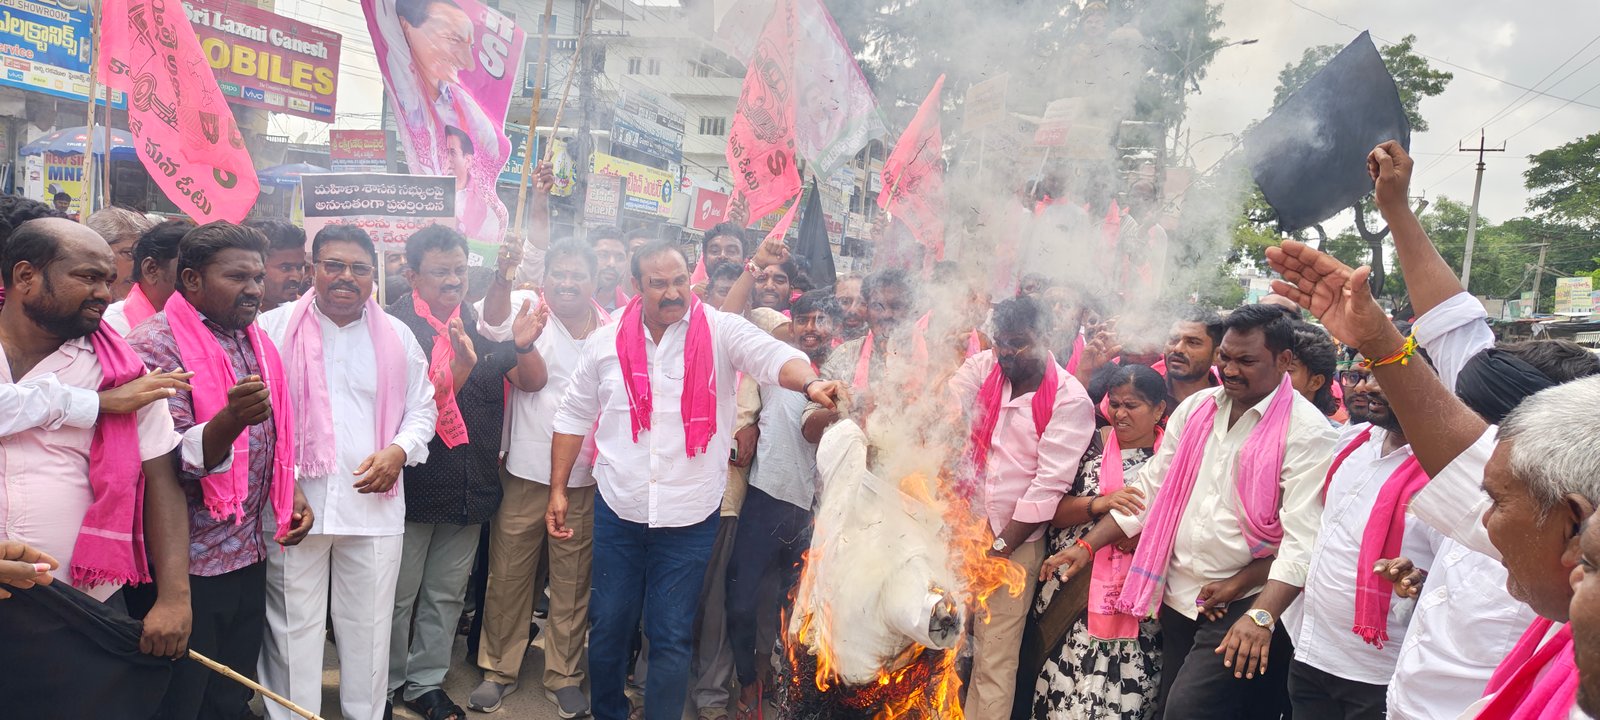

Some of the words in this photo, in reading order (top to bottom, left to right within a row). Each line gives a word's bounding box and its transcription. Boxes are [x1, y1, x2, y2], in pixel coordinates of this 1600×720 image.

[17, 1, 70, 22] SHOWROOM
[182, 2, 209, 26] Sri
[212, 11, 268, 43] Laxmi
[269, 28, 328, 59] Ganesh
[196, 33, 334, 96] OBILES
[71, 154, 85, 166] SI
[145, 137, 181, 178] మన
[175, 176, 212, 216] ఓటు
[730, 131, 745, 159] మన
[738, 158, 760, 191] ఓటు
[314, 183, 360, 195] మహిళా
[361, 184, 397, 195] శాసన
[398, 185, 445, 200] సభ్యులపై
[314, 198, 385, 211] అనుచితంగా
[386, 199, 445, 214] ప్రవర్తించిన
